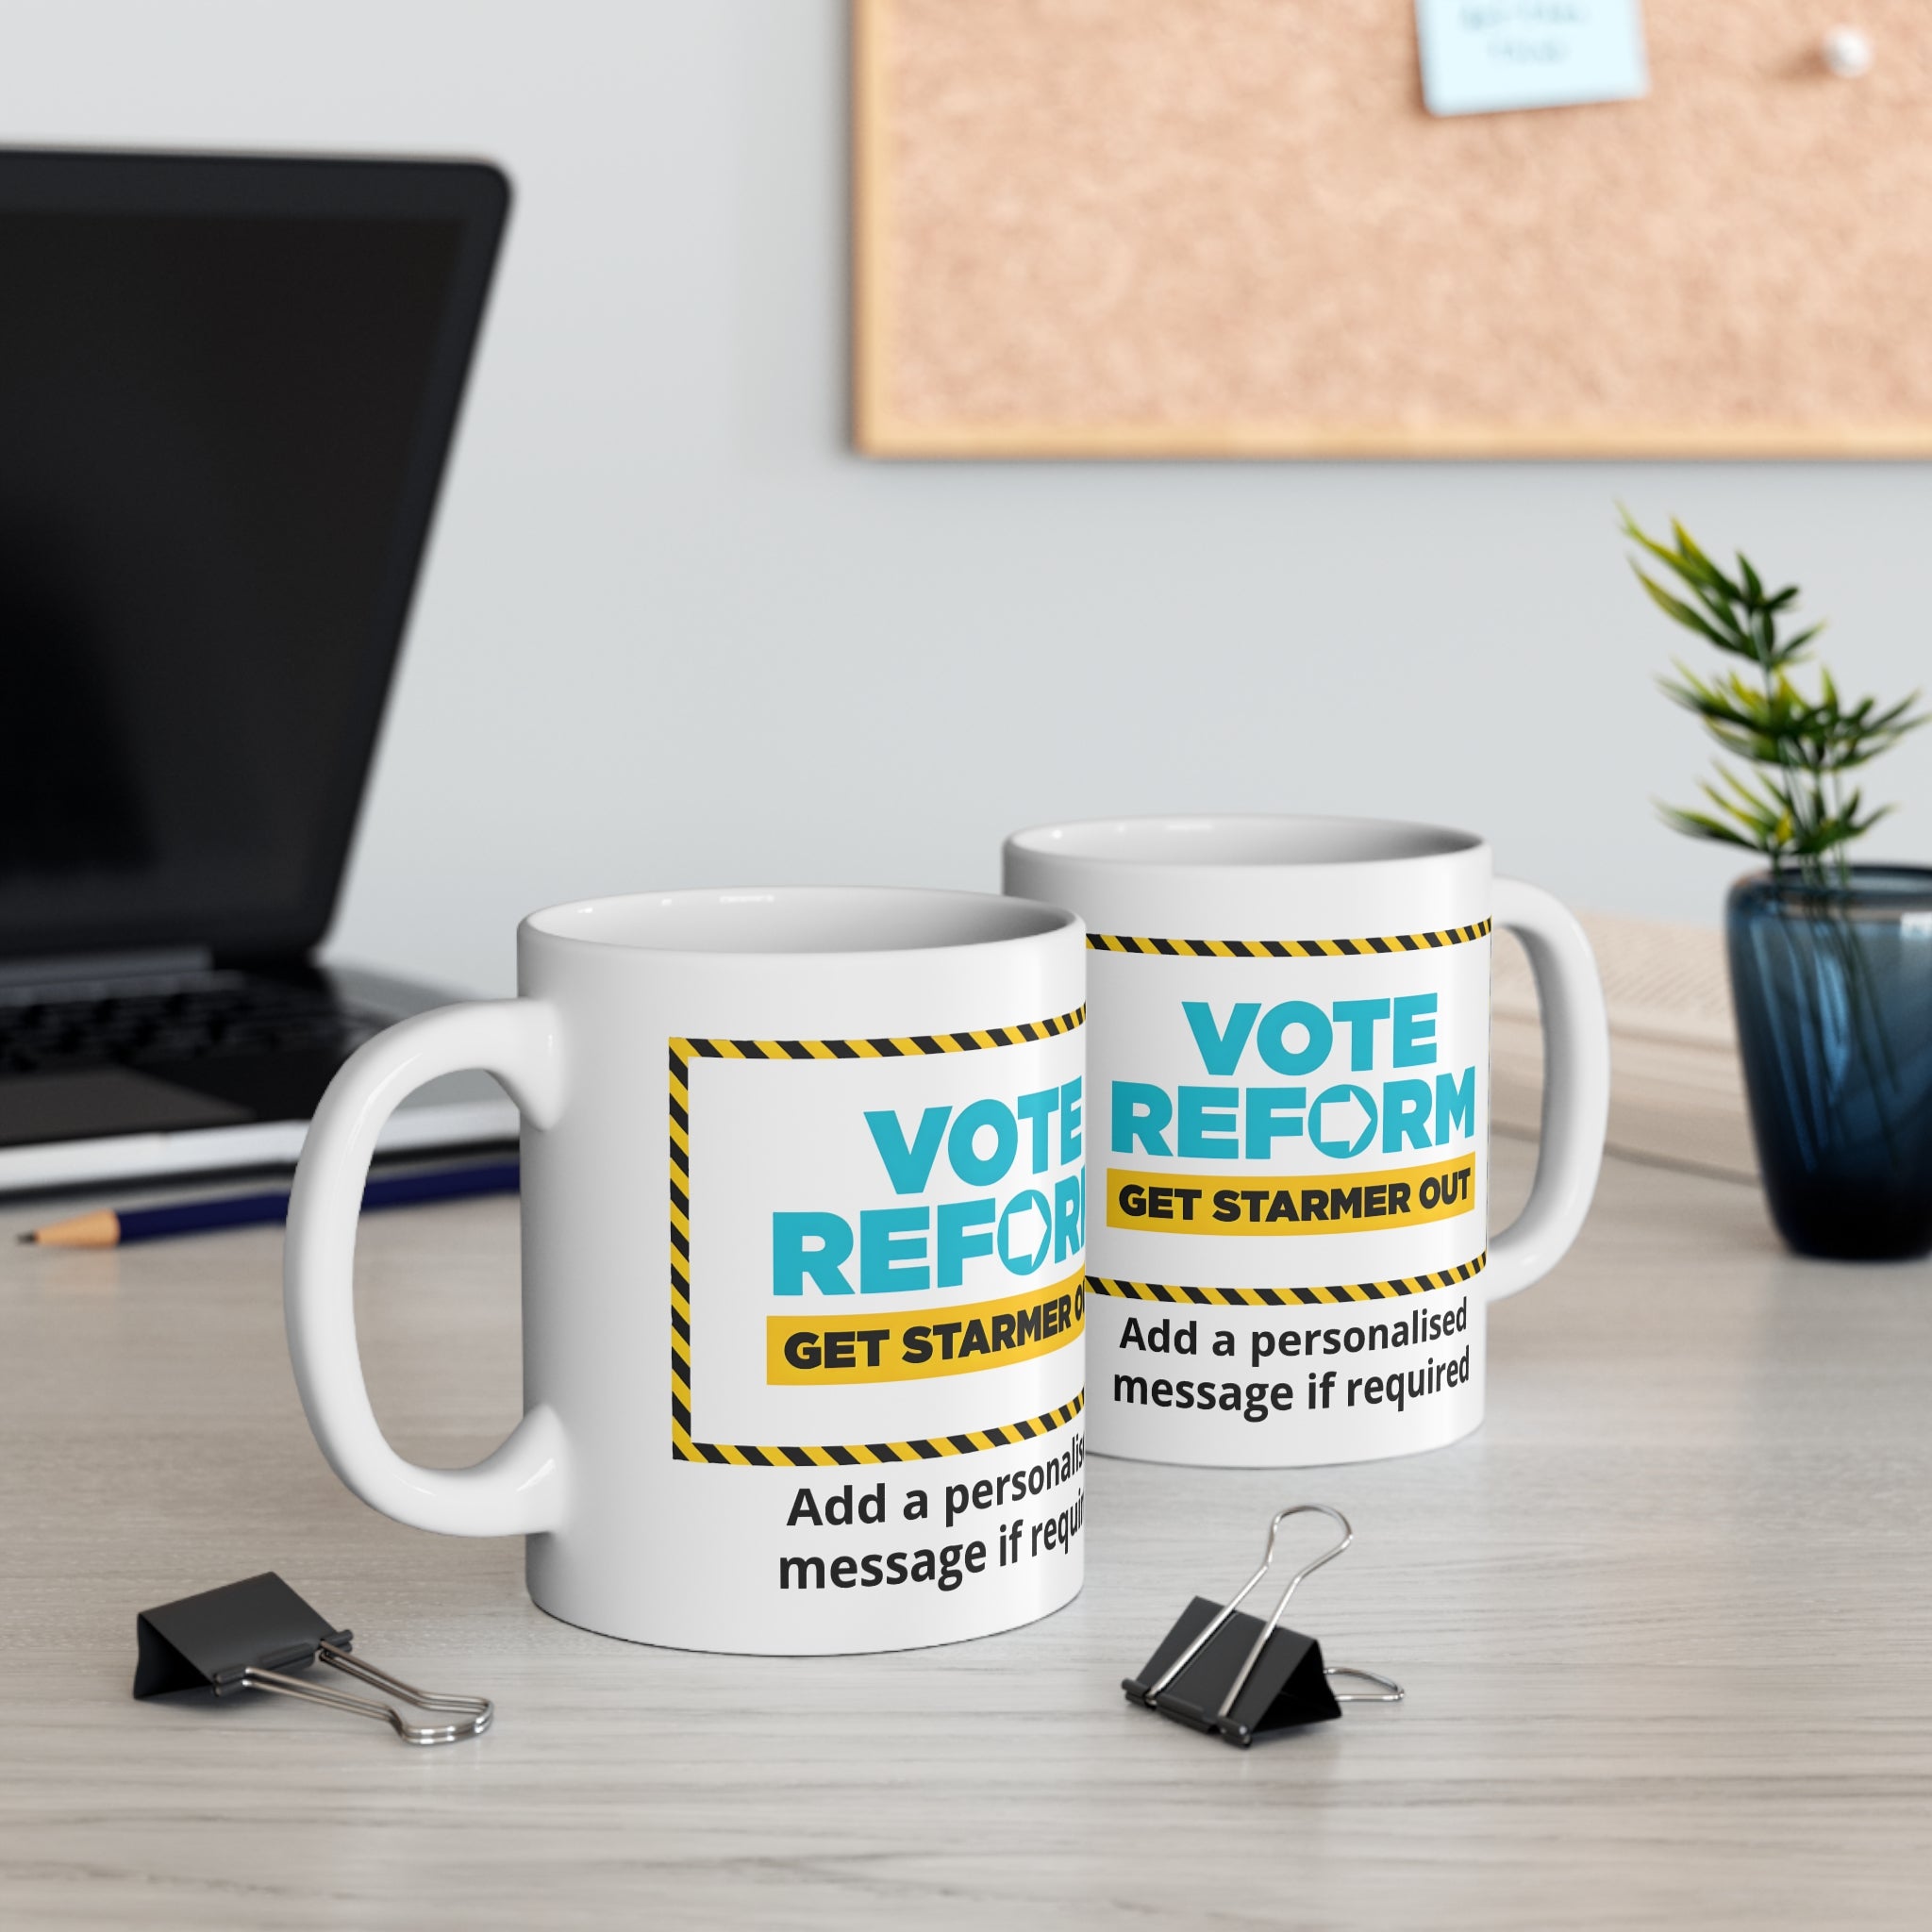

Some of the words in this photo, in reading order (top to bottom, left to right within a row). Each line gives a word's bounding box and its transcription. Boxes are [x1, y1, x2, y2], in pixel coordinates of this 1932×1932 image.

[1181, 992, 1438, 1076] VOTE
[863, 1075, 1082, 1195] VOTE
[1111, 1066, 1475, 1160] REFORM
[1118, 1183, 1203, 1221] GET
[1212, 1182, 1411, 1223] STARMER
[1419, 1167, 1471, 1209] OUT
[784, 1328, 891, 1370] GET
[902, 1294, 1072, 1364] STARMER
[1119, 1316, 1197, 1356] Add
[1211, 1330, 1235, 1357] a
[1251, 1296, 1467, 1367] personalised
[1113, 1374, 1293, 1423] message
[1308, 1371, 1338, 1409] if
[1347, 1344, 1470, 1412] required
[786, 1482, 886, 1526] Add
[903, 1490, 928, 1521] a
[945, 1433, 1085, 1527] personalis
[779, 1541, 987, 1591] message
[999, 1519, 1024, 1567] if
[1031, 1488, 1085, 1557] requir
